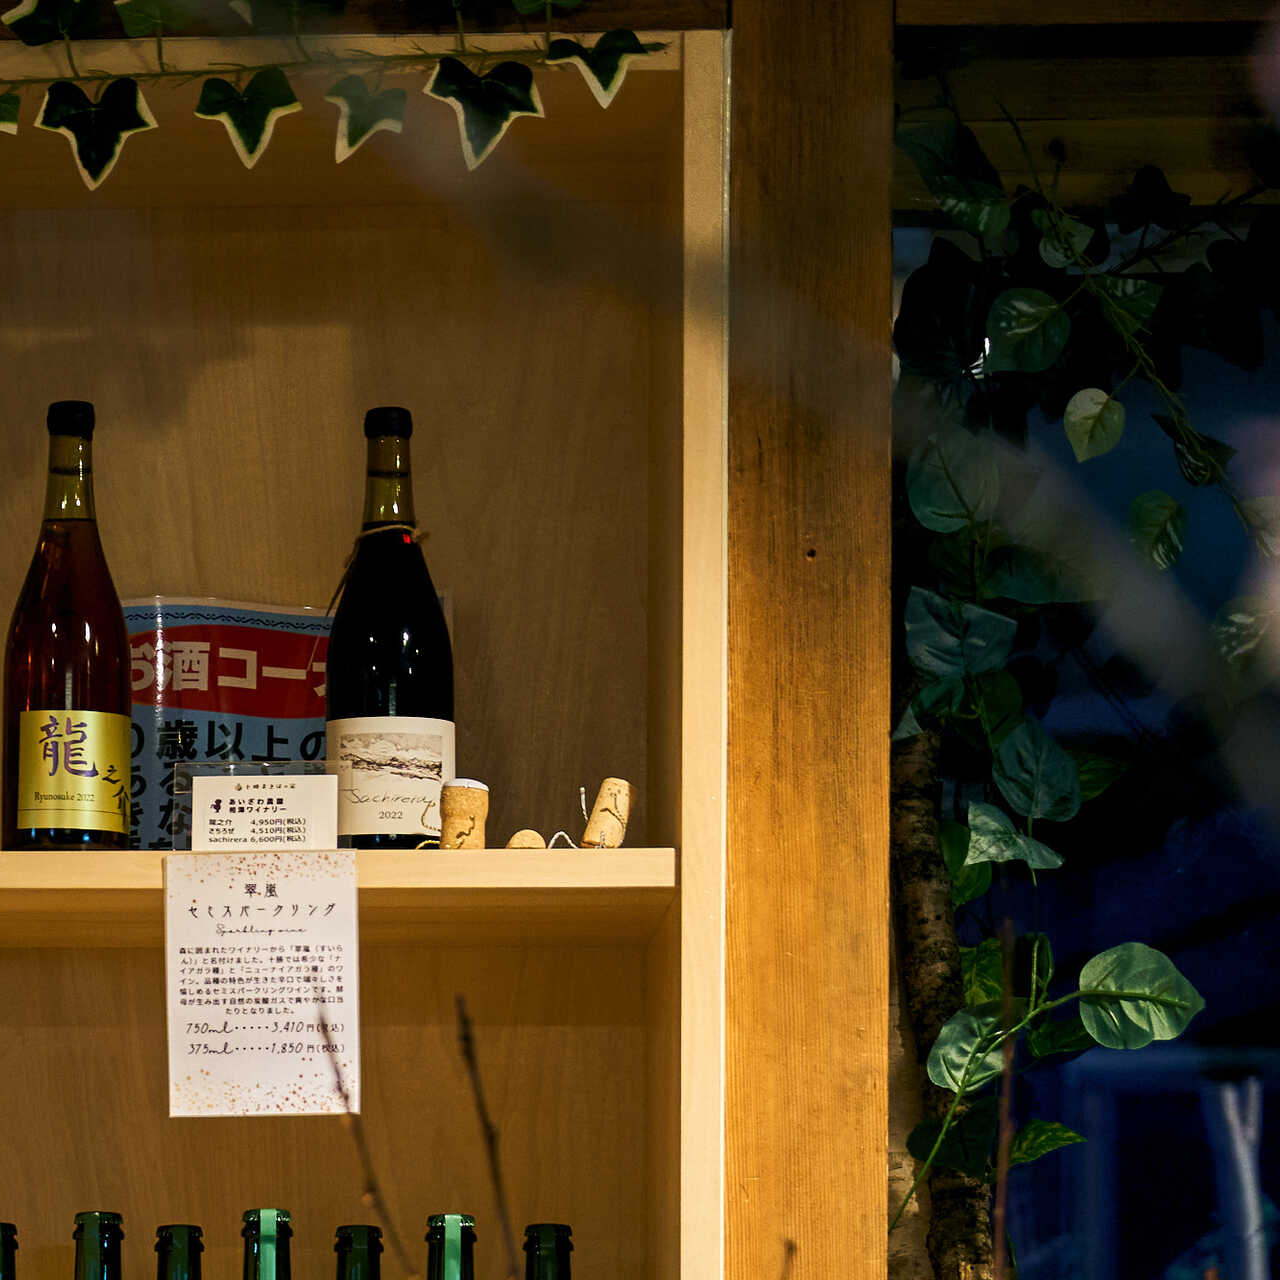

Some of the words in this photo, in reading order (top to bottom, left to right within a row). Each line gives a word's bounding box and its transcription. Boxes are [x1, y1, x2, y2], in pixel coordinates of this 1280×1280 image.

[34, 791, 75, 802] Ryunosuke
[77, 793, 96, 802] 2022
[378, 811, 403, 819] 2022
[244, 883, 278, 898] 翠嵐
[188, 903, 336, 918] セミスパークリング
